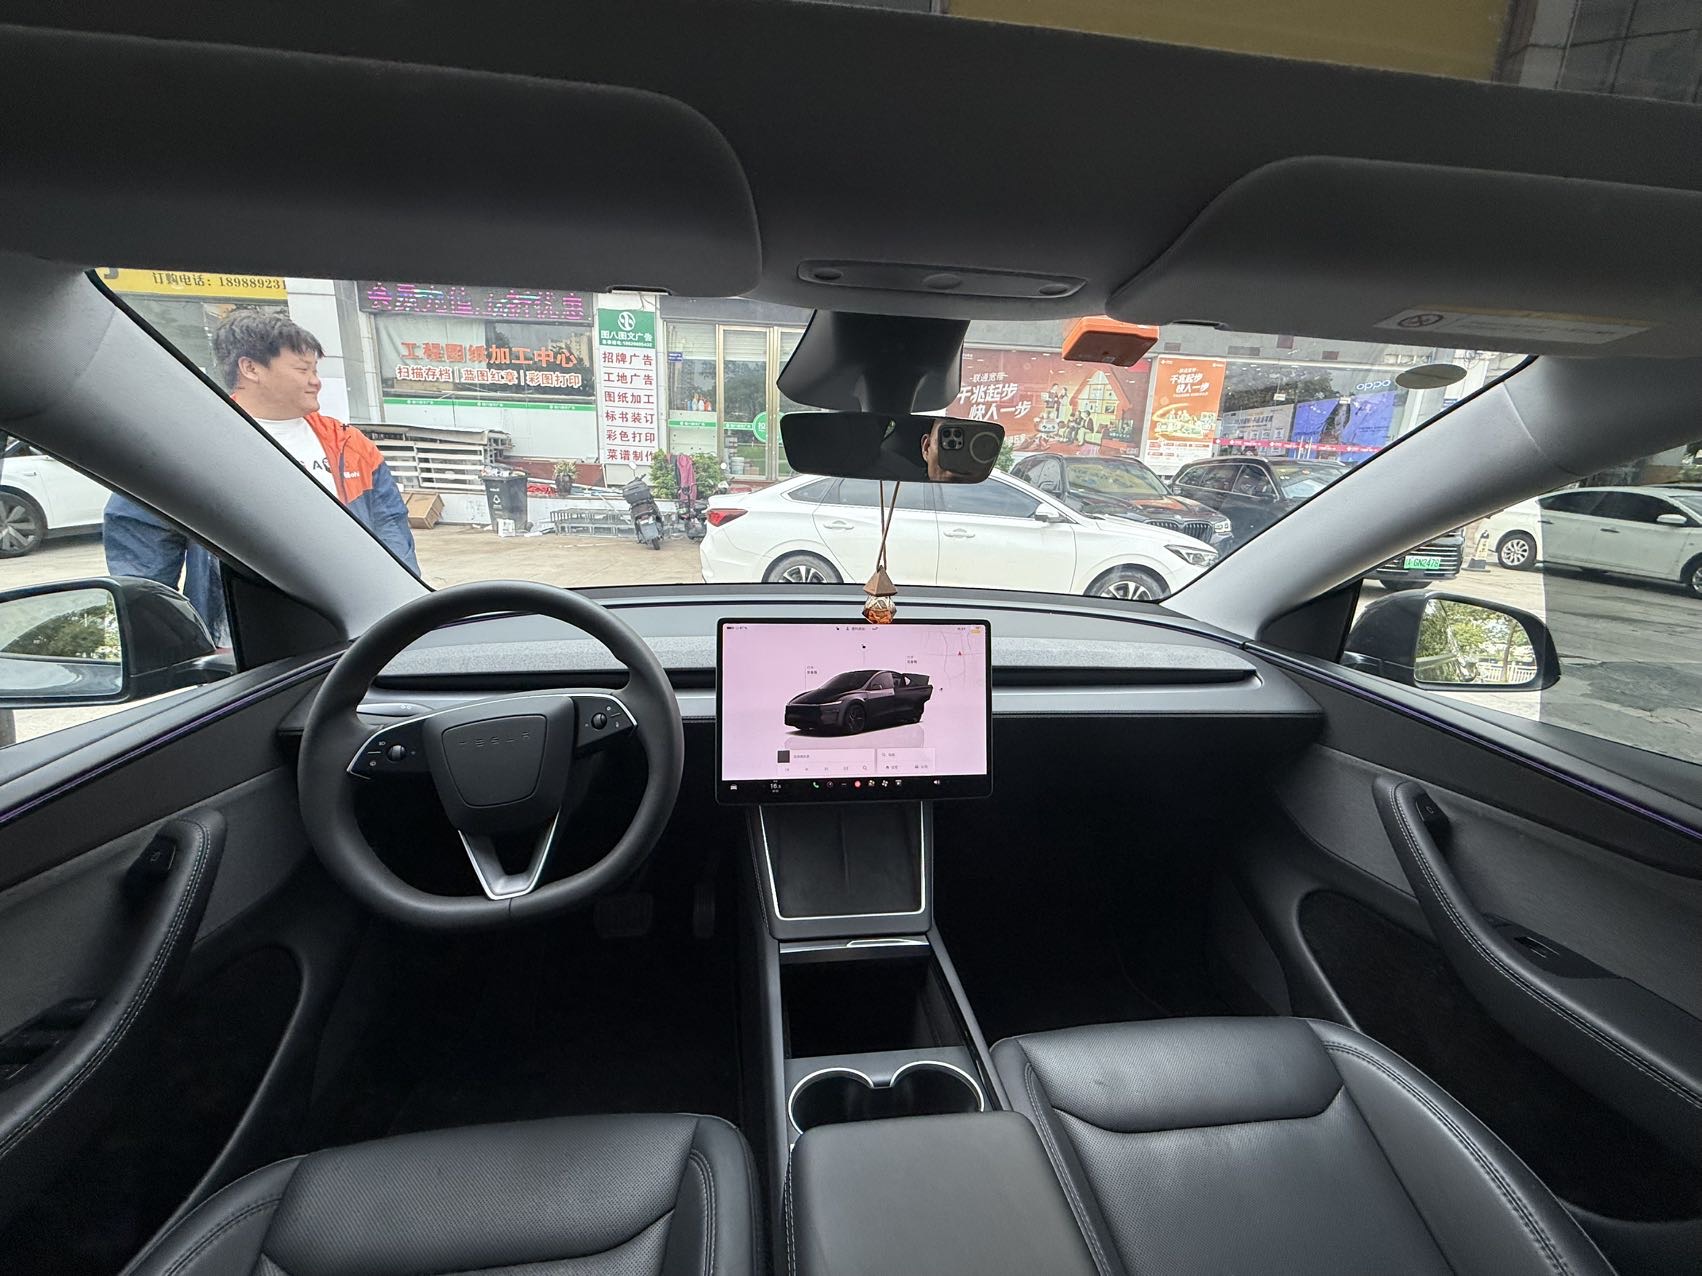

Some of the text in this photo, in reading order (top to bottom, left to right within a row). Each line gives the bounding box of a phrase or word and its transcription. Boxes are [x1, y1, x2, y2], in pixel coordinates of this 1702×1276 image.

[400, 342, 578, 368] 工程图纸加工中心
[602, 351, 654, 366] 招牌广告
[396, 365, 452, 383] 扫描存档
[525, 371, 583, 389] 彩图打印
[603, 372, 654, 386] 工地广告
[604, 391, 655, 405] 图纸加工
[605, 409, 656, 425] 标书装订
[606, 429, 656, 444] 彩色打印
